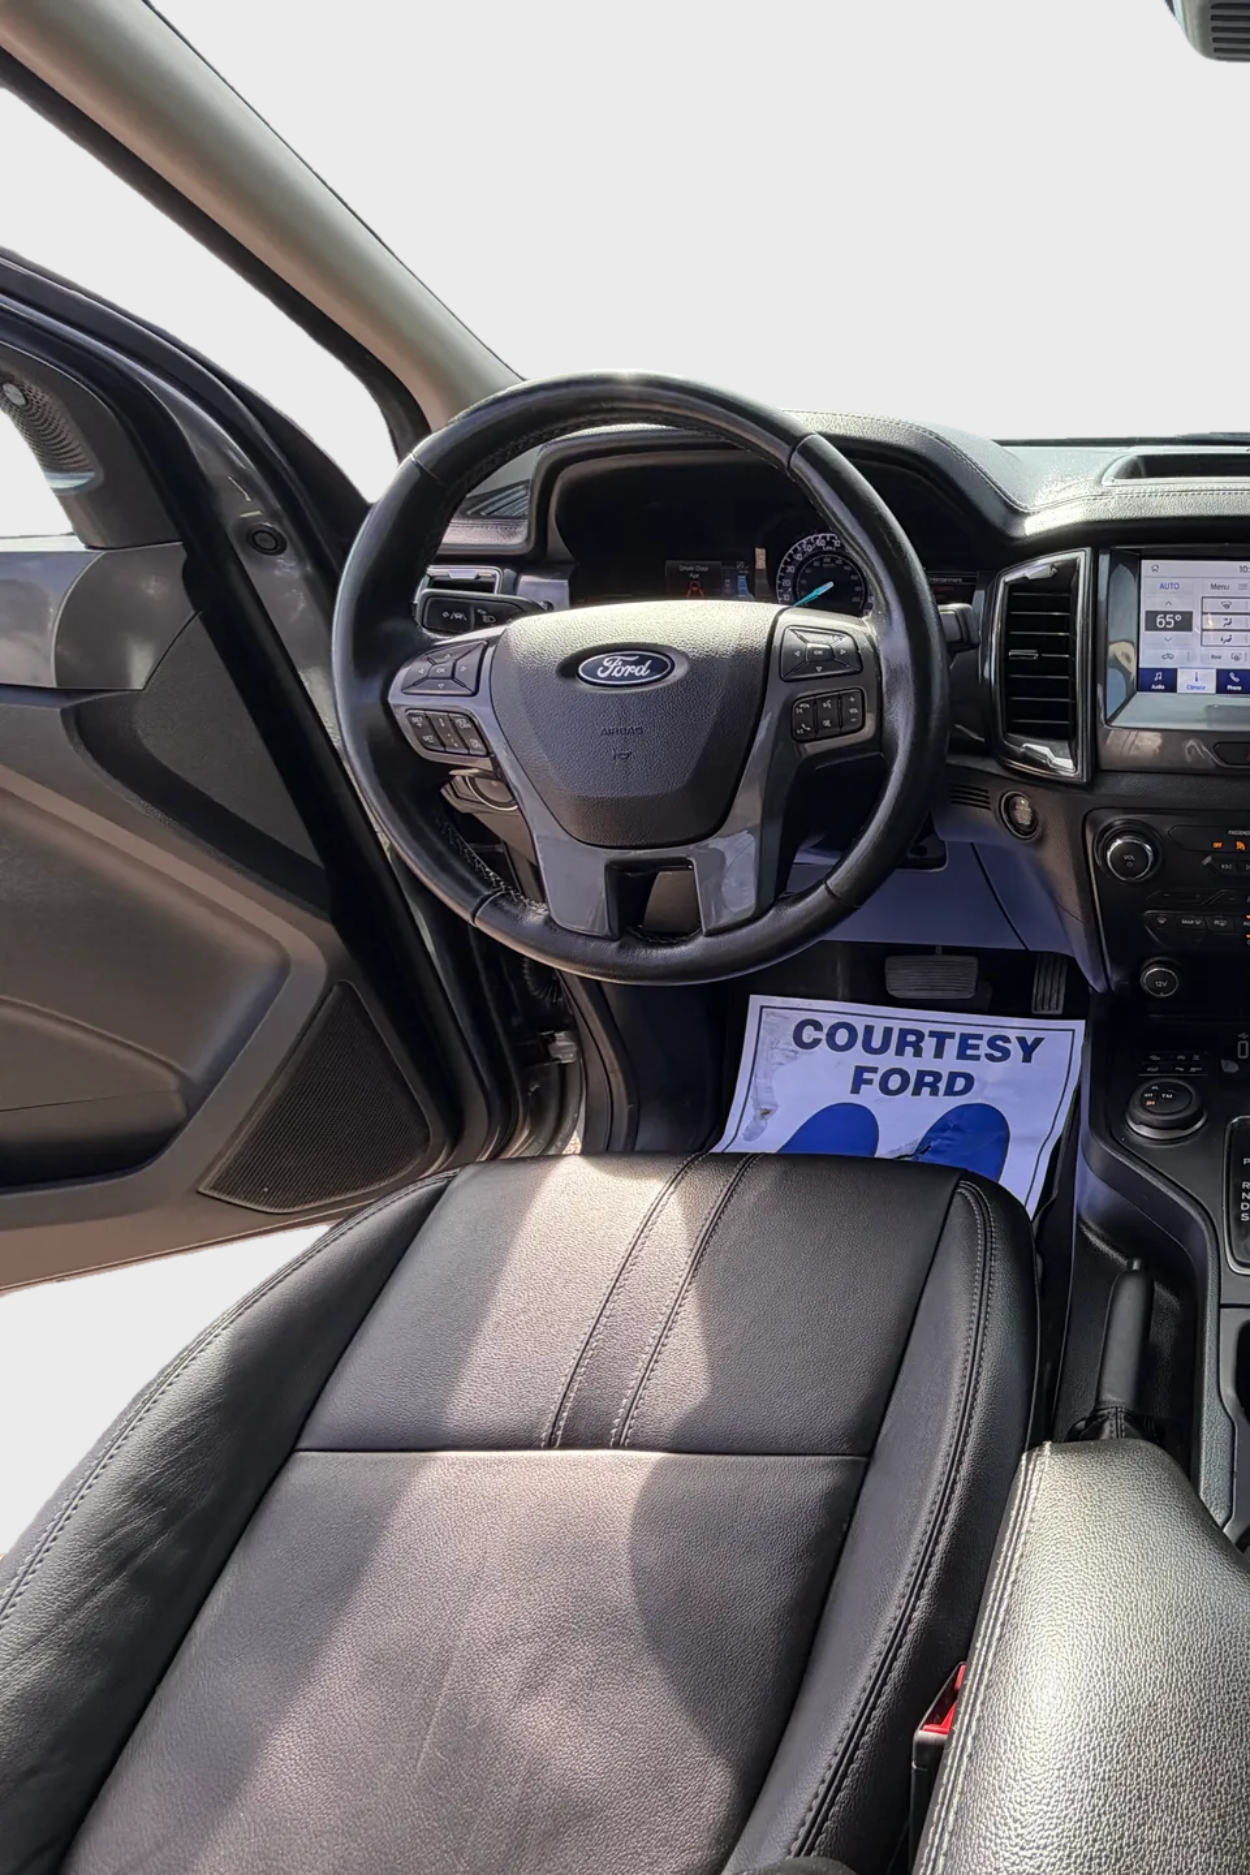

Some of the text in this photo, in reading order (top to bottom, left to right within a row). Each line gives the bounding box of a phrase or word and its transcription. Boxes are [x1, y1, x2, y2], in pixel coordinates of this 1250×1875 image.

[1210, 583, 1230, 591] Menu
[1156, 614, 1182, 628] 65°
[597, 655, 652, 678] Ford
[792, 1018, 1045, 1063] COURTESY
[850, 1065, 975, 1097] FORD
[1242, 1181, 1250, 1189] R
[1242, 1192, 1250, 1200] N
[1240, 1213, 1249, 1221] S
